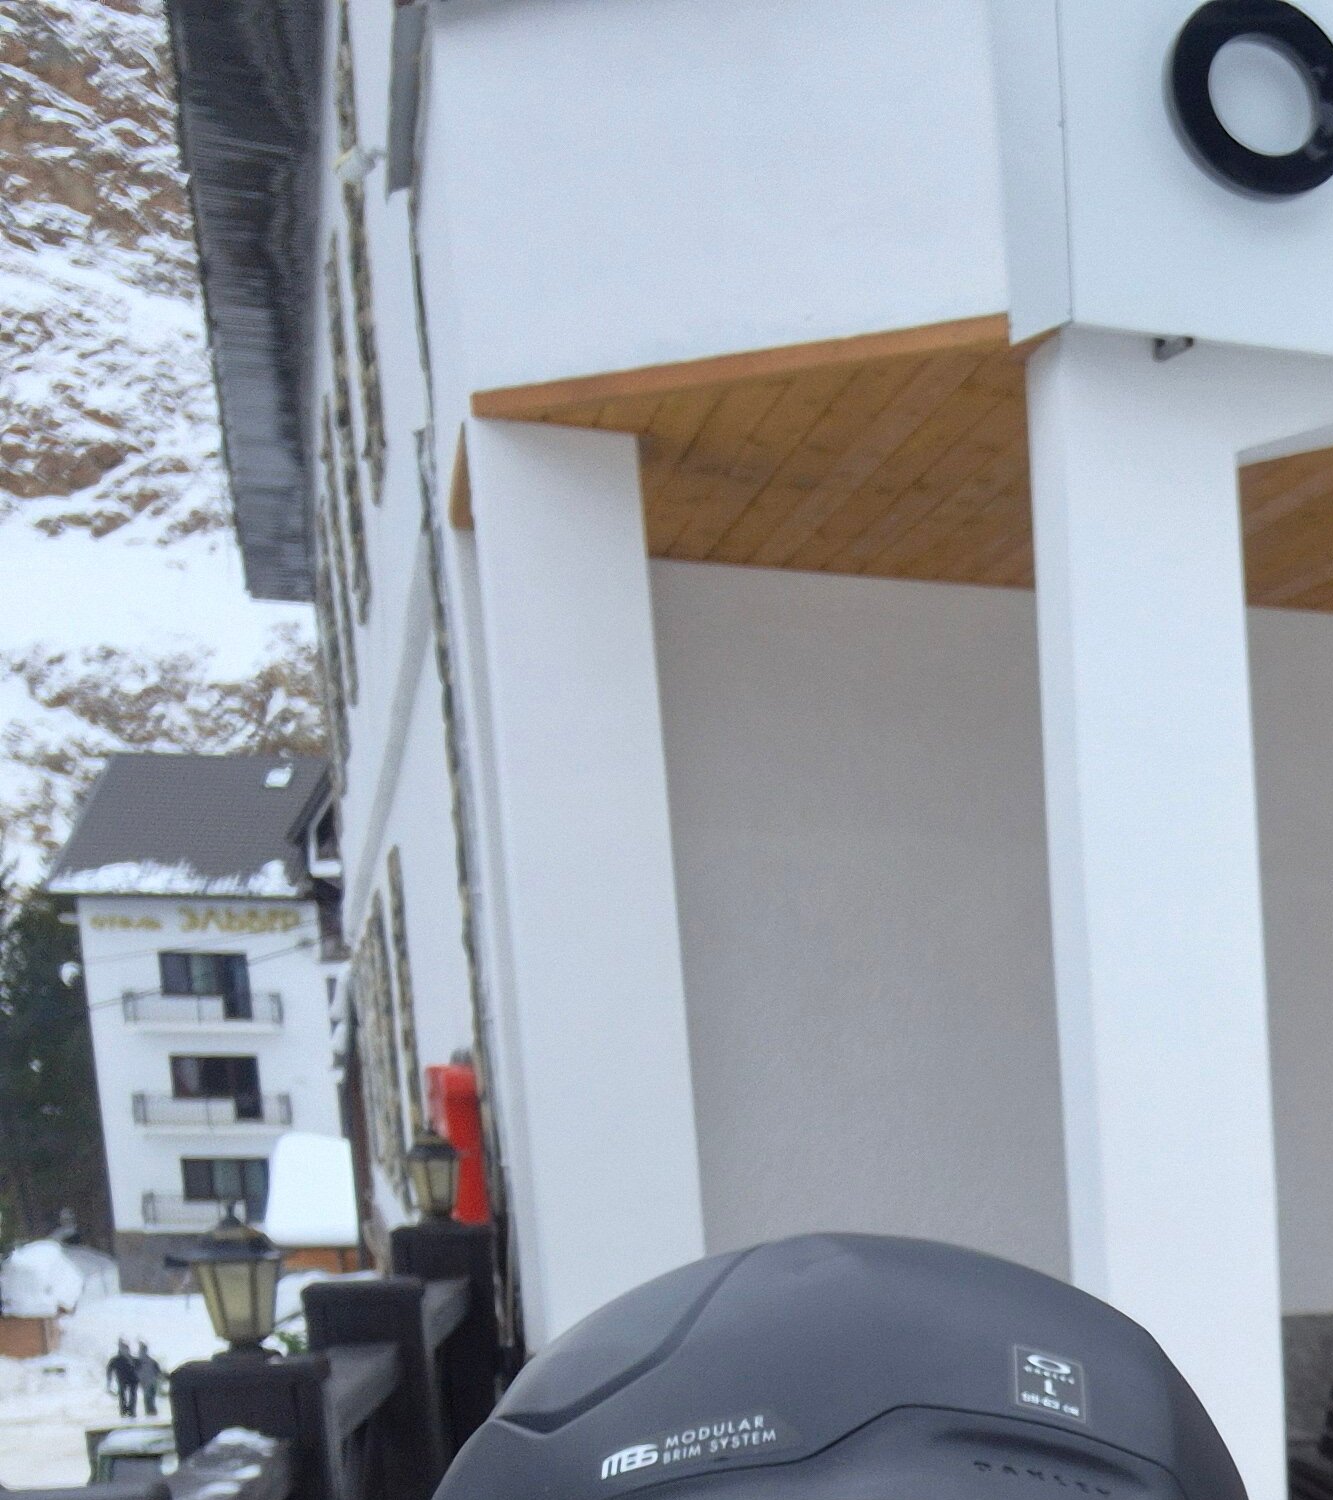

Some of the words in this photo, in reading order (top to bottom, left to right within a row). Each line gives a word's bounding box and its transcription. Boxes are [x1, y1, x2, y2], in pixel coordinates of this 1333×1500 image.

[663, 1443, 701, 1465] BRIM
[709, 1429, 777, 1453] SYSTEM
[665, 1414, 764, 1449] MODULAR
